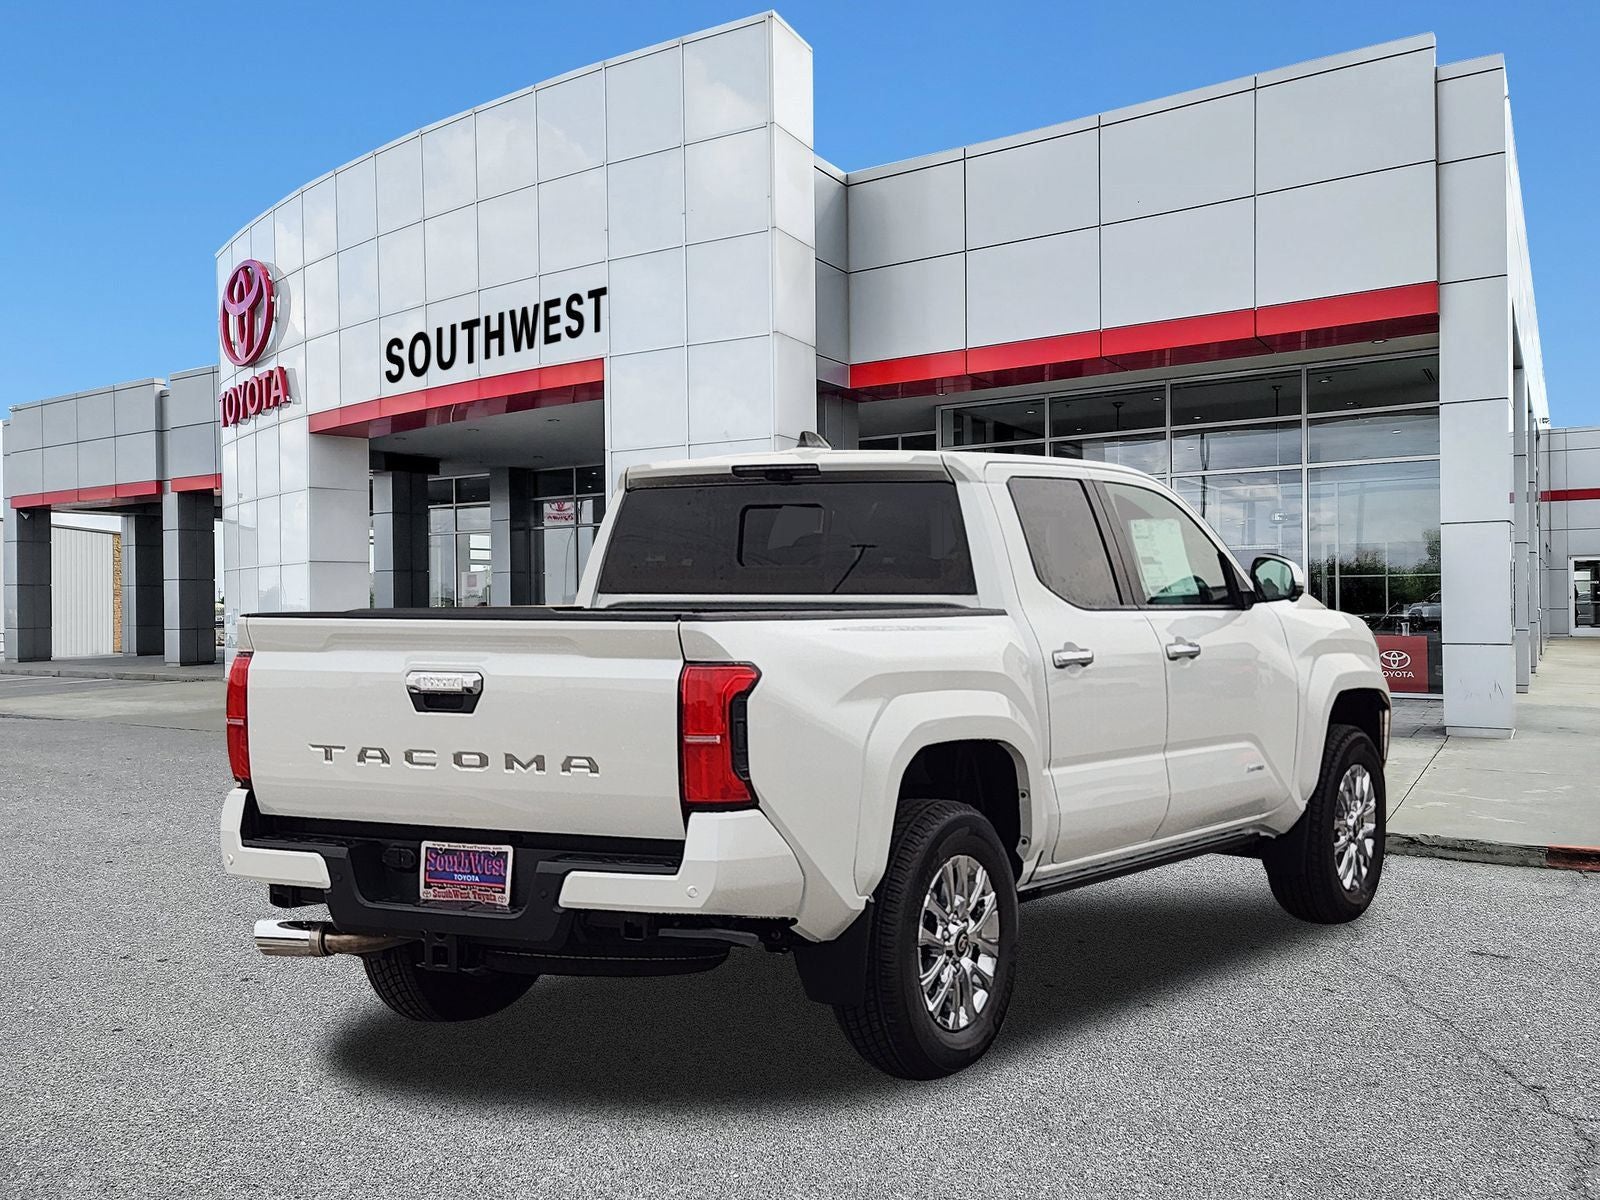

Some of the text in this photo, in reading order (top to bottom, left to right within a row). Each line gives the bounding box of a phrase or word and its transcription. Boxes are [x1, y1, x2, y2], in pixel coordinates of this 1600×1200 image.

[385, 287, 608, 383] SOUTHWEST
[218, 366, 290, 428] TOYOTA
[1381, 670, 1415, 678] OYOTA
[308, 743, 601, 778] TACOMA
[454, 873, 480, 882] TOYOTA
[472, 891, 497, 903] Toyota
